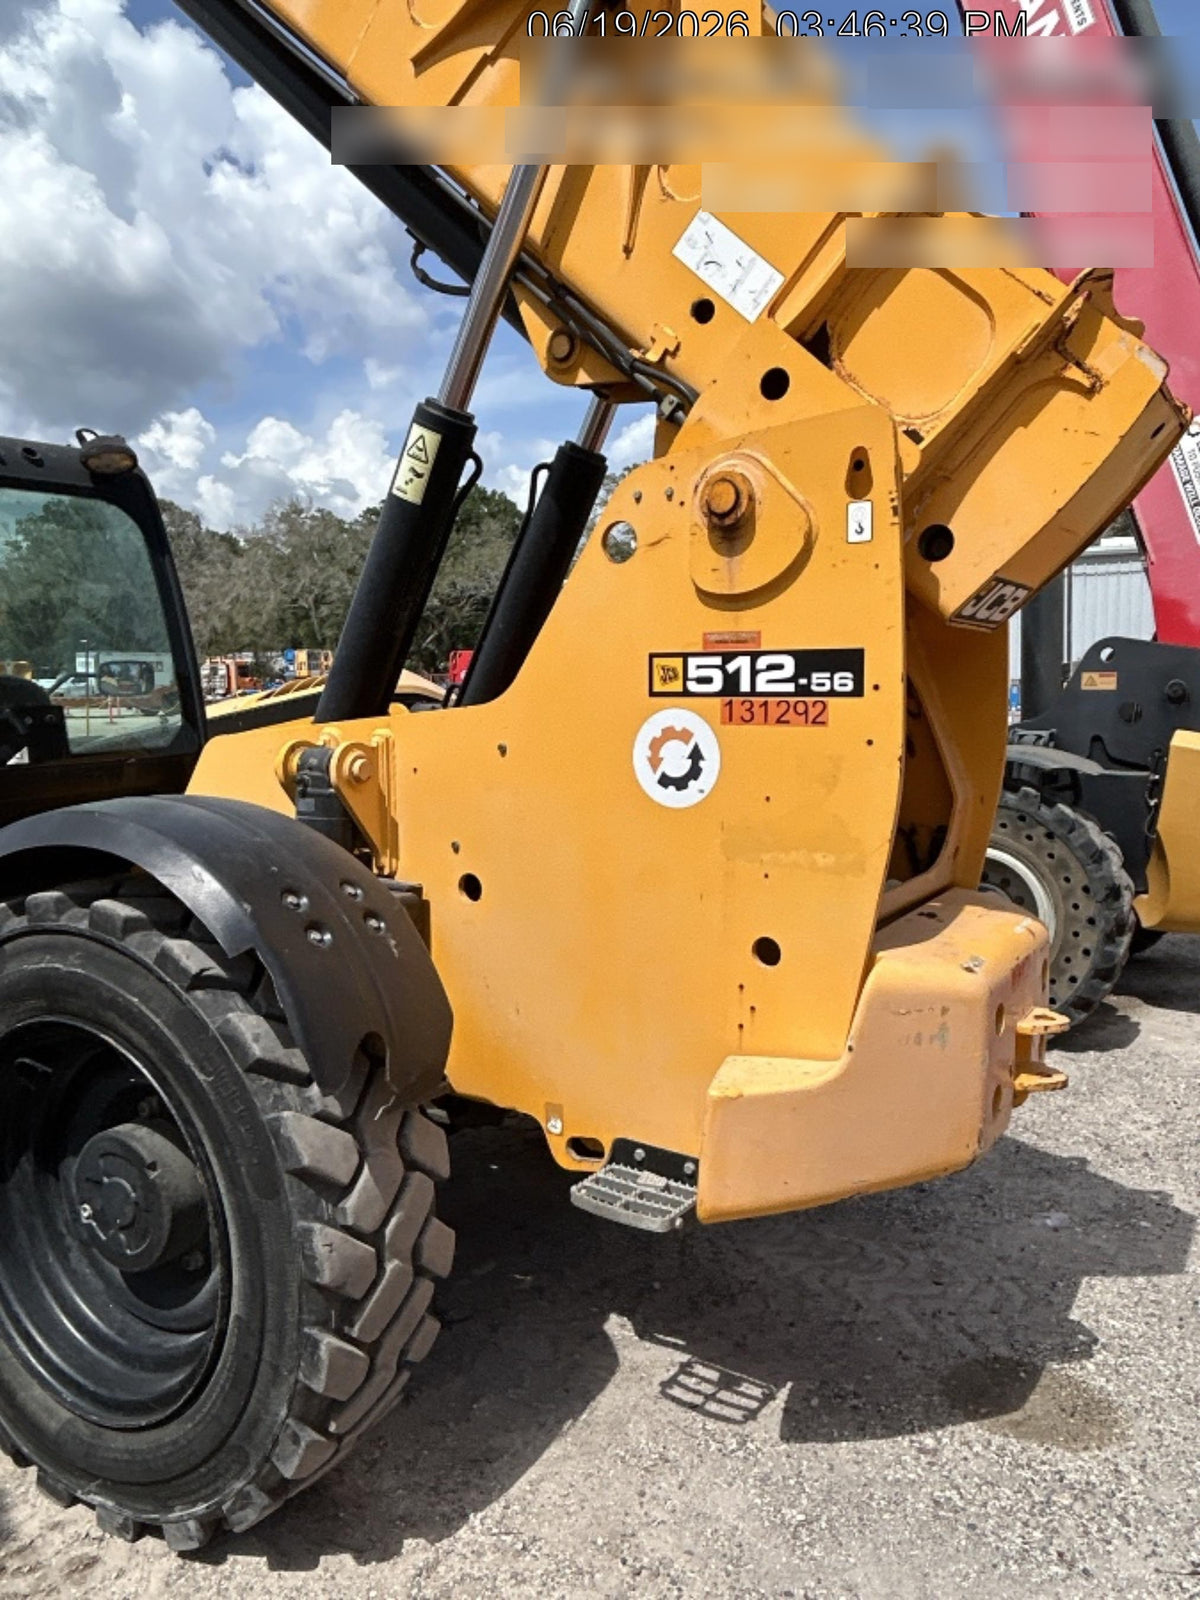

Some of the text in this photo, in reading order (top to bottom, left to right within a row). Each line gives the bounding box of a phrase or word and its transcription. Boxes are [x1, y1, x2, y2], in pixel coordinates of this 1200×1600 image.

[961, 582, 1029, 621] JCB
[686, 654, 854, 693] 512-56
[724, 700, 827, 724] 131292
